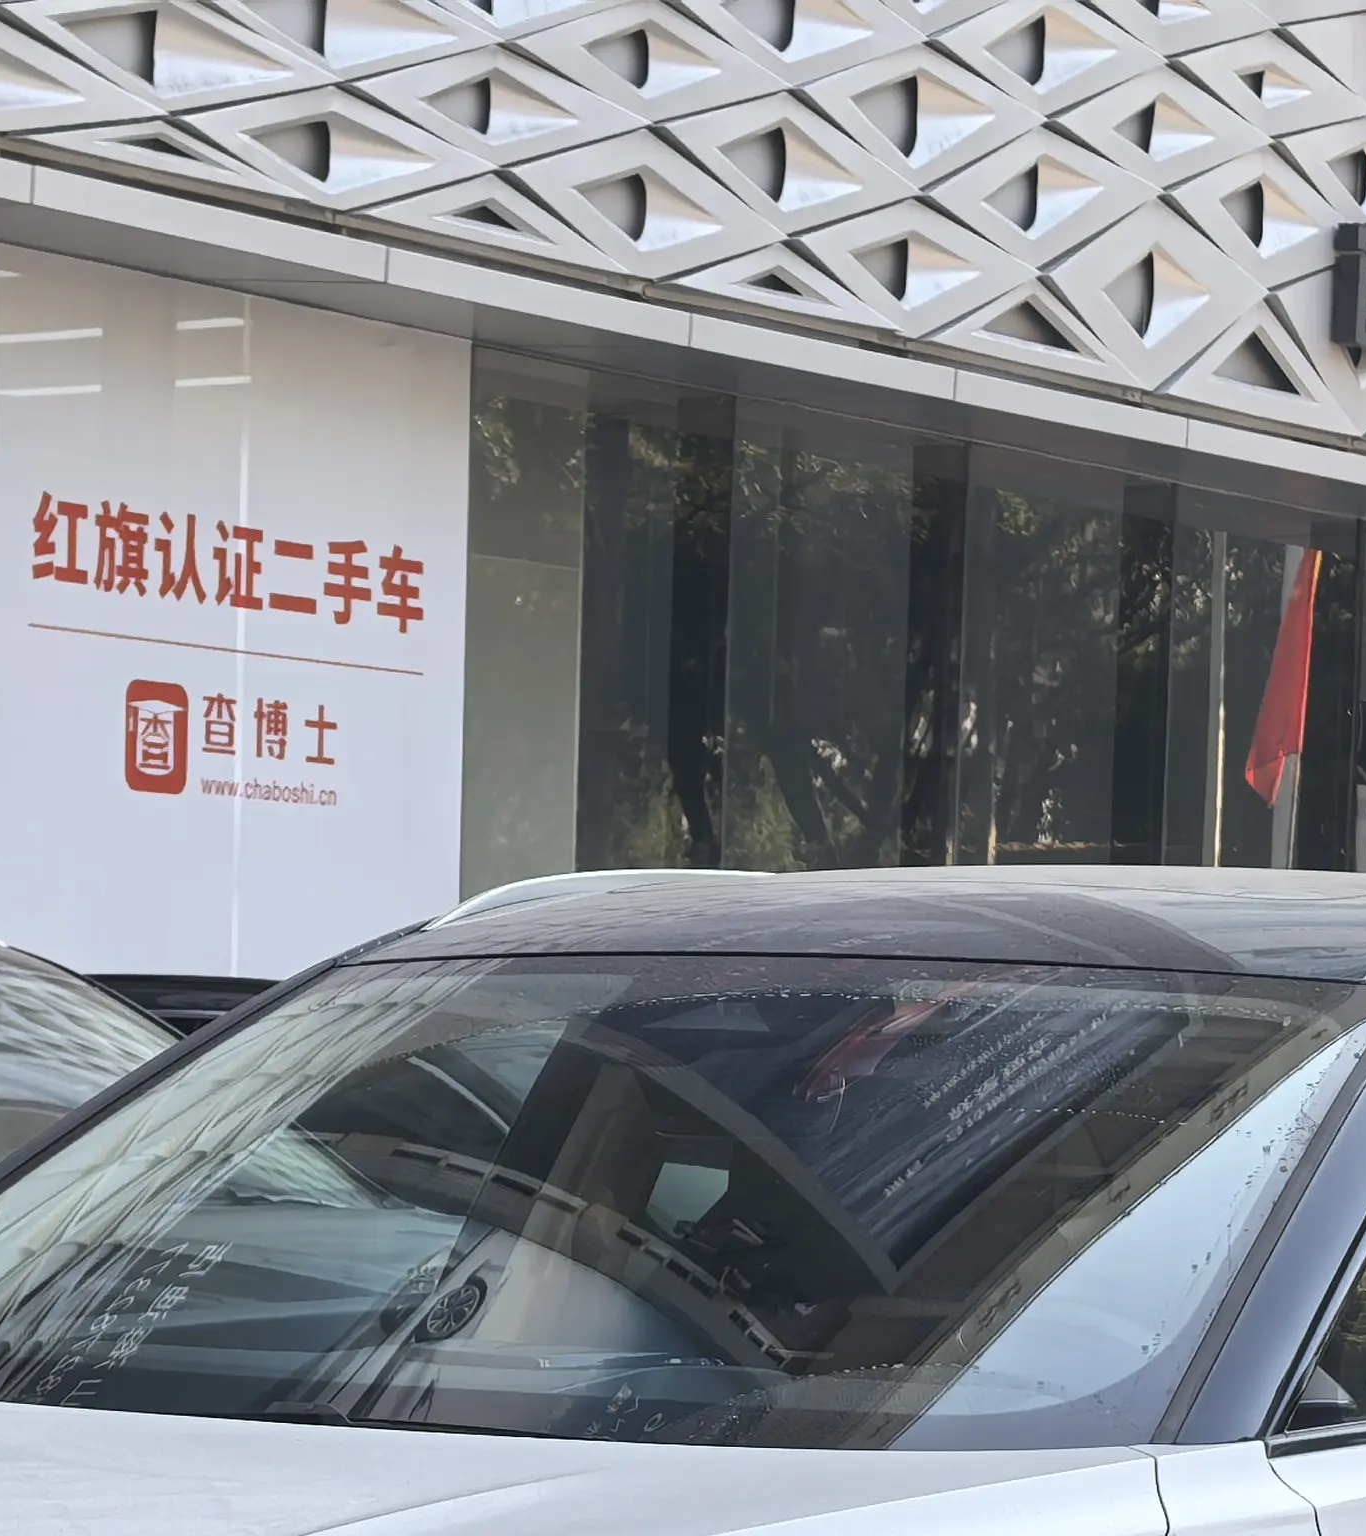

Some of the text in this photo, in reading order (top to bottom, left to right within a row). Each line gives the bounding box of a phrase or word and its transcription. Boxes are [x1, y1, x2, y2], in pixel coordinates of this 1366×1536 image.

[32, 490, 424, 634] 红旗认证二手车
[201, 693, 338, 766] 查博士
[200, 776, 338, 807] www.chaboshi.cn
